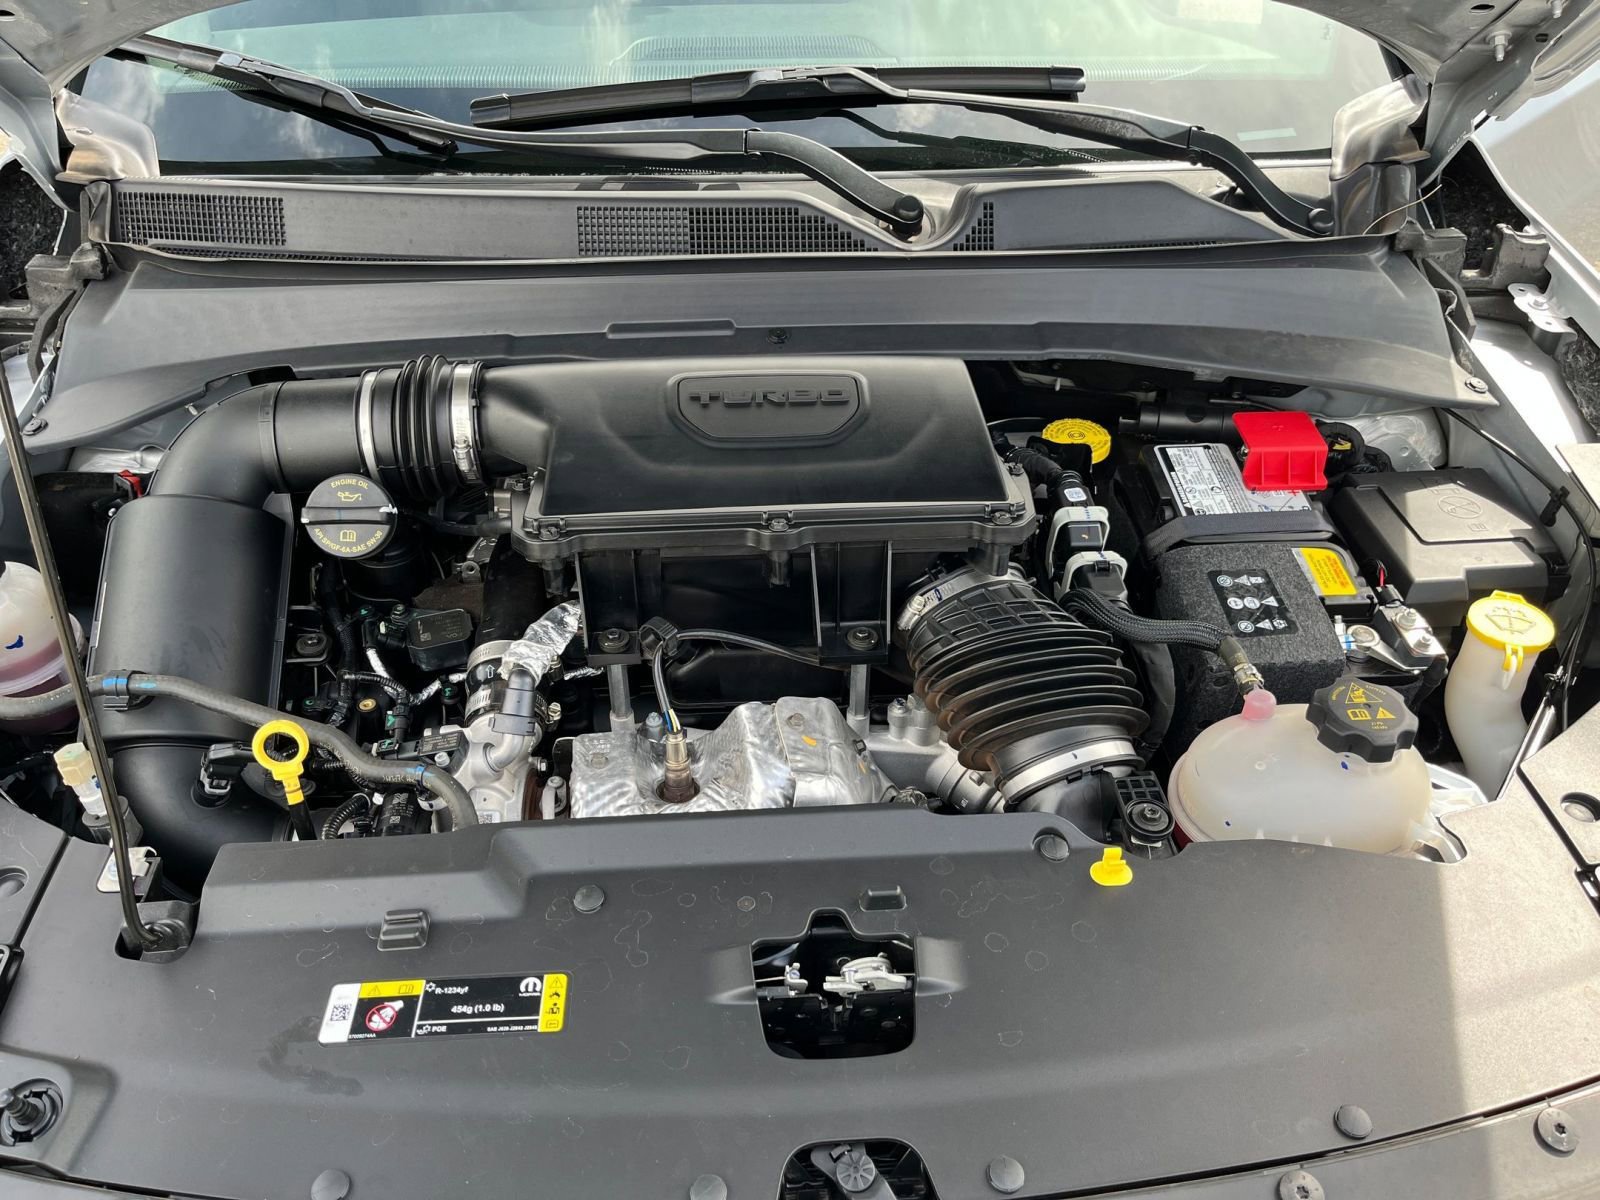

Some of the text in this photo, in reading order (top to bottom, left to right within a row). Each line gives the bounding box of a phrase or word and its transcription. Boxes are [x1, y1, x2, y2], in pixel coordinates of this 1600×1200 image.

[688, 389, 850, 406] TURBO
[330, 479, 369, 490] ENGINE OIL
[314, 528, 325, 540] API
[366, 530, 383, 547] 5W-30
[435, 986, 469, 995] R-1234yf
[451, 1003, 505, 1014] 454g (1.0 lb)
[432, 1025, 447, 1033] POE
